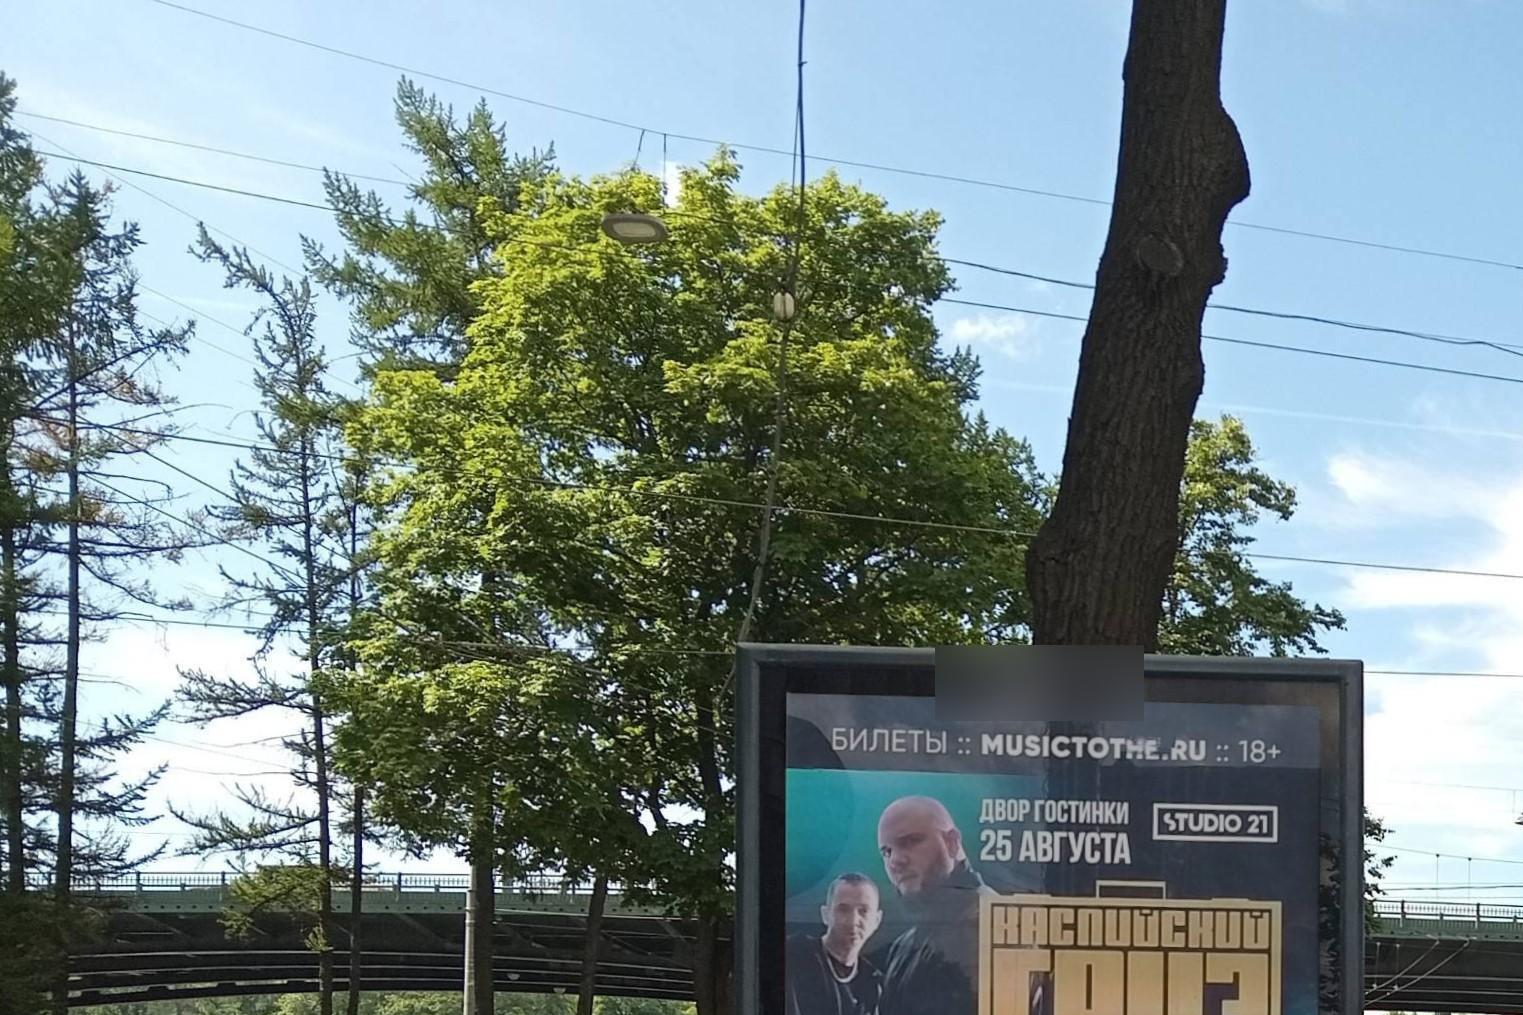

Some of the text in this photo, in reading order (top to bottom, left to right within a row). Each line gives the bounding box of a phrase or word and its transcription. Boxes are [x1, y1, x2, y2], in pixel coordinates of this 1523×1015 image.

[832, 727, 947, 754] БИЛЕТЫ
[981, 733, 1206, 761] MUSICTOTHE.RU
[1238, 740, 1281, 763] 18+
[979, 798, 1129, 826] ДВОР ГОСТИНКИ
[1163, 812, 1270, 835] STUDIO 21
[980, 829, 1131, 864] 25 АВГУСТА
[992, 905, 1270, 950] КАСПИЙСКИЙ
